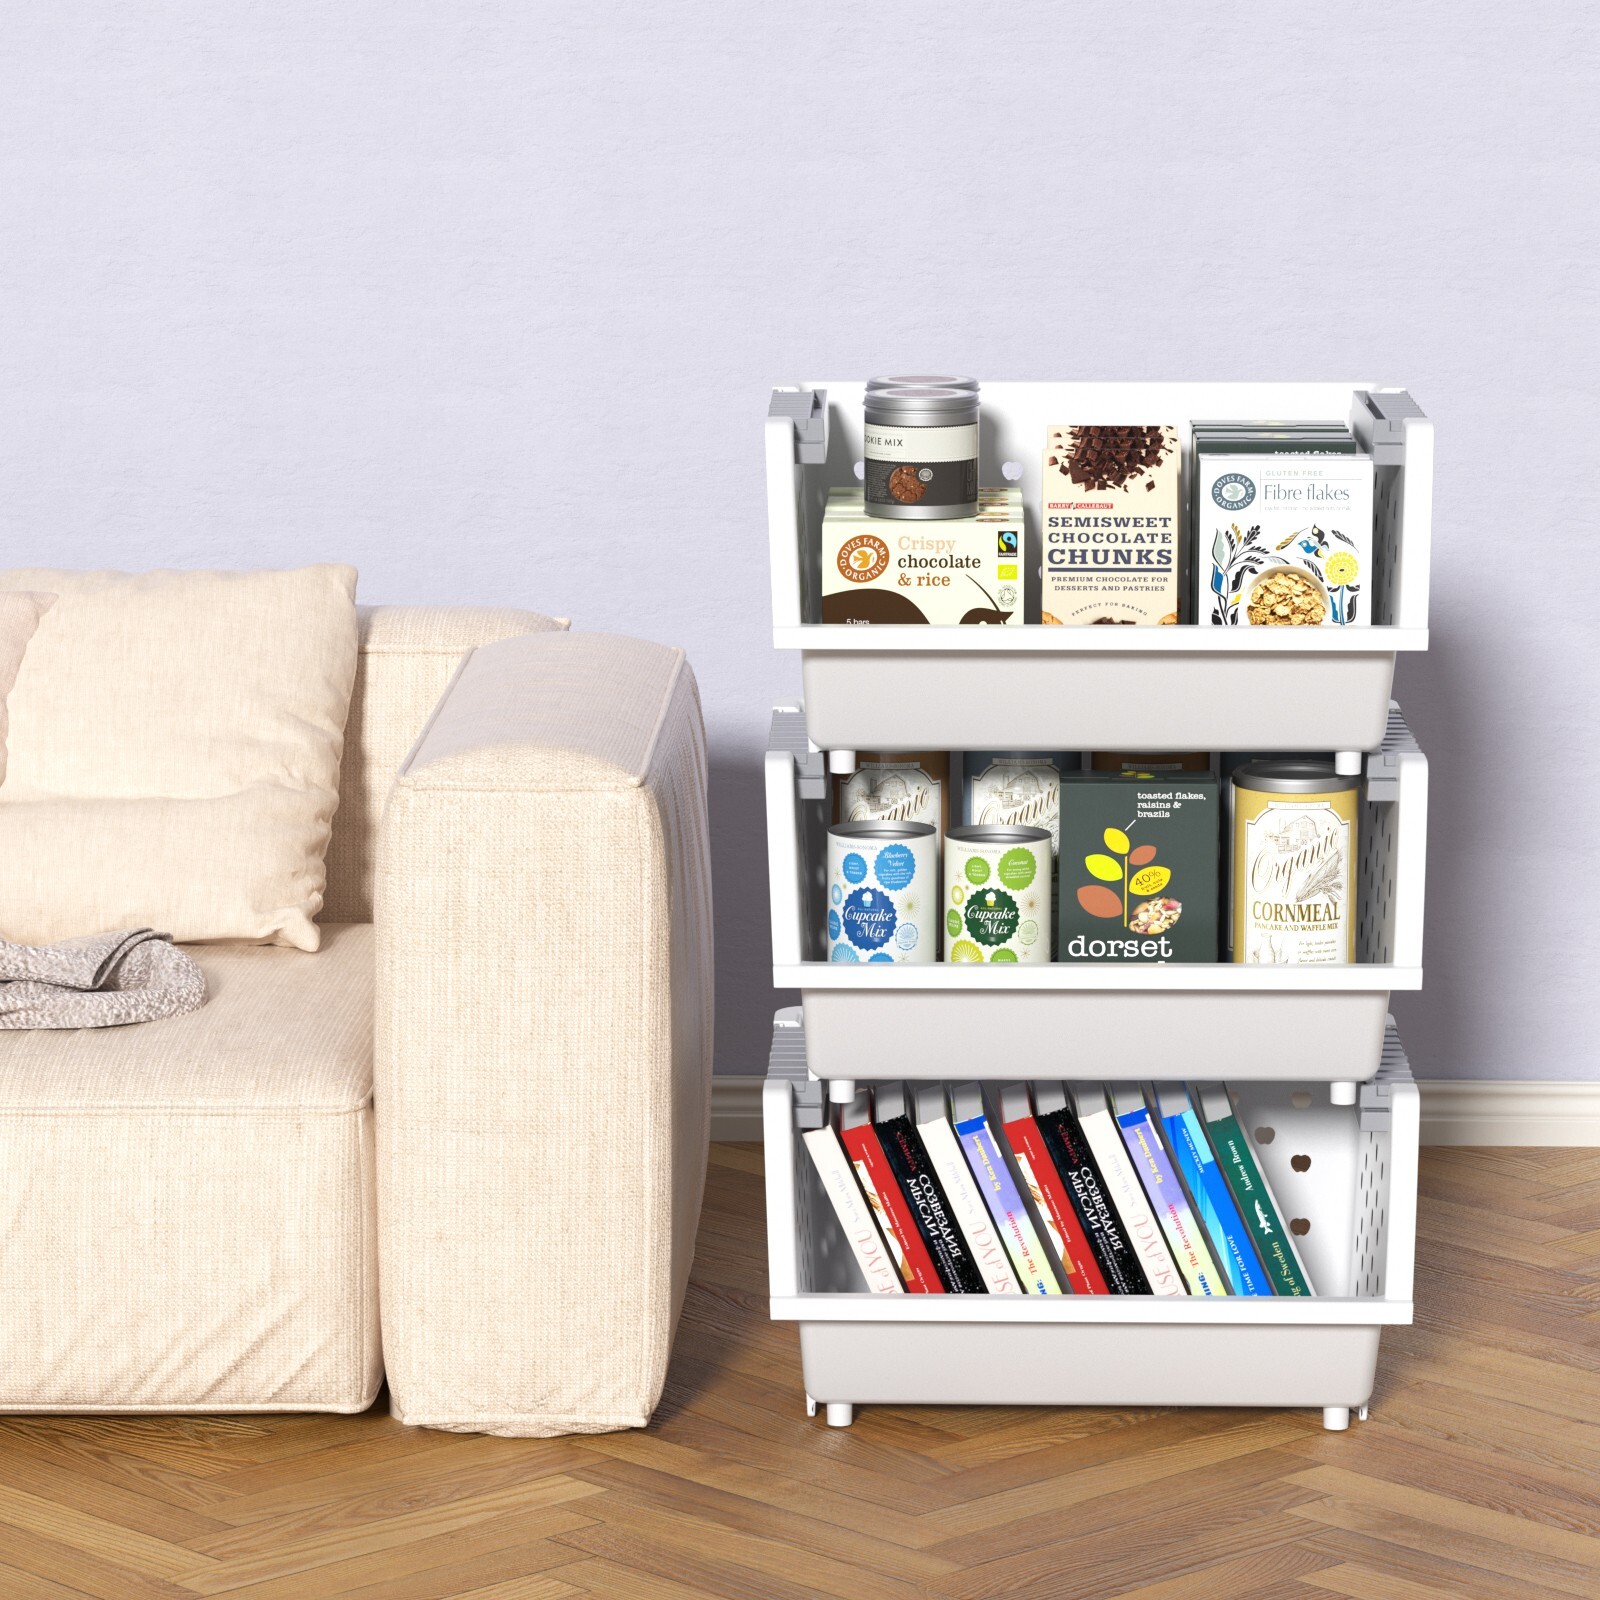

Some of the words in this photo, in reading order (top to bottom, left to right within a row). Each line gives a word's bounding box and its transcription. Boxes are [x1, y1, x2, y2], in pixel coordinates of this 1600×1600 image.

[884, 438, 903, 447] MIX
[1213, 474, 1236, 494] DOVES
[1236, 475, 1254, 494] FARM
[1264, 483, 1302, 501] Fibre
[1307, 483, 1350, 501] flakes
[1216, 495, 1253, 509] ORGANIC
[1048, 516, 1172, 528] SEMISWEET
[898, 535, 956, 555] Crispy
[1048, 532, 1172, 544] CHOCOLATE
[839, 537, 862, 567] DOVES
[863, 537, 885, 557] FARM
[898, 554, 981, 568] chocolate
[1048, 548, 1172, 565] CHUNKS
[844, 559, 886, 581] ORGANIC
[898, 573, 912, 587] &
[917, 573, 950, 587] rice
[1071, 602, 1102, 617] PERFECT
[1121, 603, 1148, 616] BAKING
[1137, 792, 1173, 800] toasted
[1175, 792, 1206, 801] flakes,
[1137, 810, 1170, 818] brazils
[1135, 869, 1161, 886] 40%
[844, 905, 893, 924] Cupcake
[967, 905, 1016, 922] Cupcake
[1252, 901, 1341, 923] CORNMEAL
[856, 922, 888, 938] Mix
[980, 920, 1011, 935] Mix
[1254, 922, 1282, 931] PANCAKE
[1284, 924, 1299, 932] AND
[1300, 923, 1326, 932] WAFFLE
[1327, 922, 1339, 930] MIX
[1067, 935, 1173, 958] dorset
[1227, 1140, 1243, 1164] Brown
[984, 1164, 997, 1181] Ken
[1146, 1157, 1158, 1173] Ken
[1235, 1163, 1254, 1192] Andrew
[906, 1178, 941, 1237] МЫСЛИ
[1068, 1170, 1103, 1230] МЫСЛИ
[1080, 1166, 1124, 1251] СОЗВЕЗДИЯ
[918, 1174, 962, 1258] СОЗВЕЗДИЯ
[1005, 1210, 1030, 1257] Revolution
[1130, 1212, 1160, 1251] YOU
[1167, 1203, 1192, 1250] Revolution
[856, 1229, 883, 1267] YOU
[969, 1221, 998, 1259] YOU
[1227, 1234, 1239, 1255] LOVE
[1024, 1257, 1038, 1275] The
[1185, 1249, 1199, 1268] The
[1235, 1255, 1247, 1271] FOR
[1271, 1241, 1291, 1276] Sweden
[1243, 1272, 1255, 1292] TIME
[1283, 1276, 1295, 1286] of
